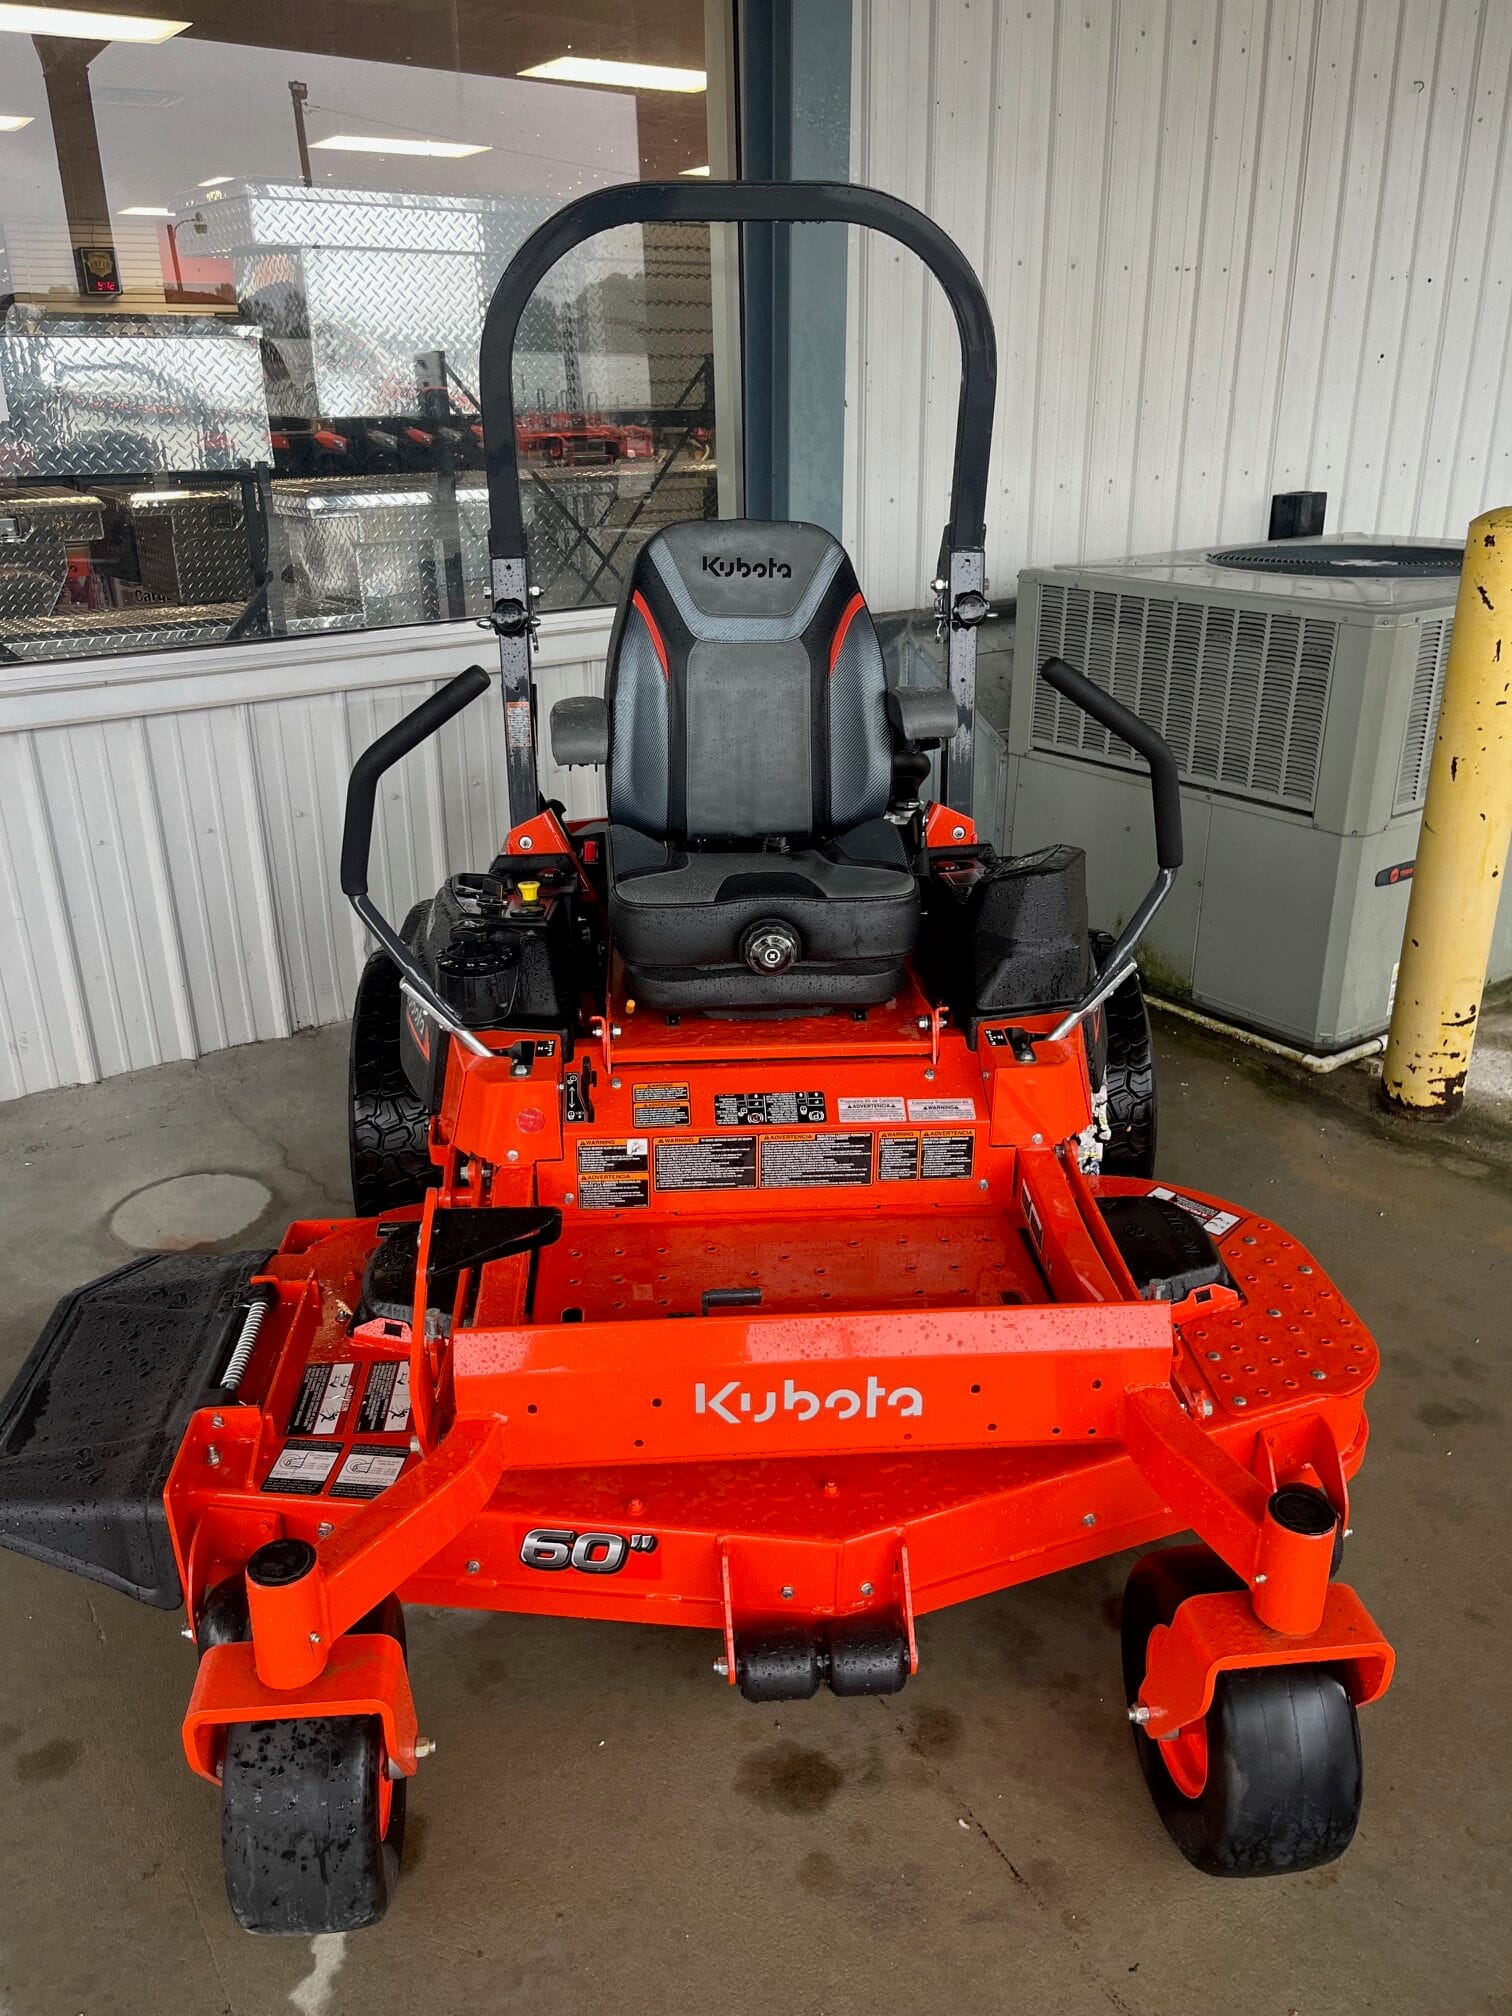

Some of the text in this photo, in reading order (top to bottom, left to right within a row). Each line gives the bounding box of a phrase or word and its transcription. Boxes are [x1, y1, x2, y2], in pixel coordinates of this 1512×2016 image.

[702, 556, 792, 578] Kubota
[695, 1376, 923, 1424] Kubota
[519, 1528, 658, 1574] 60"
